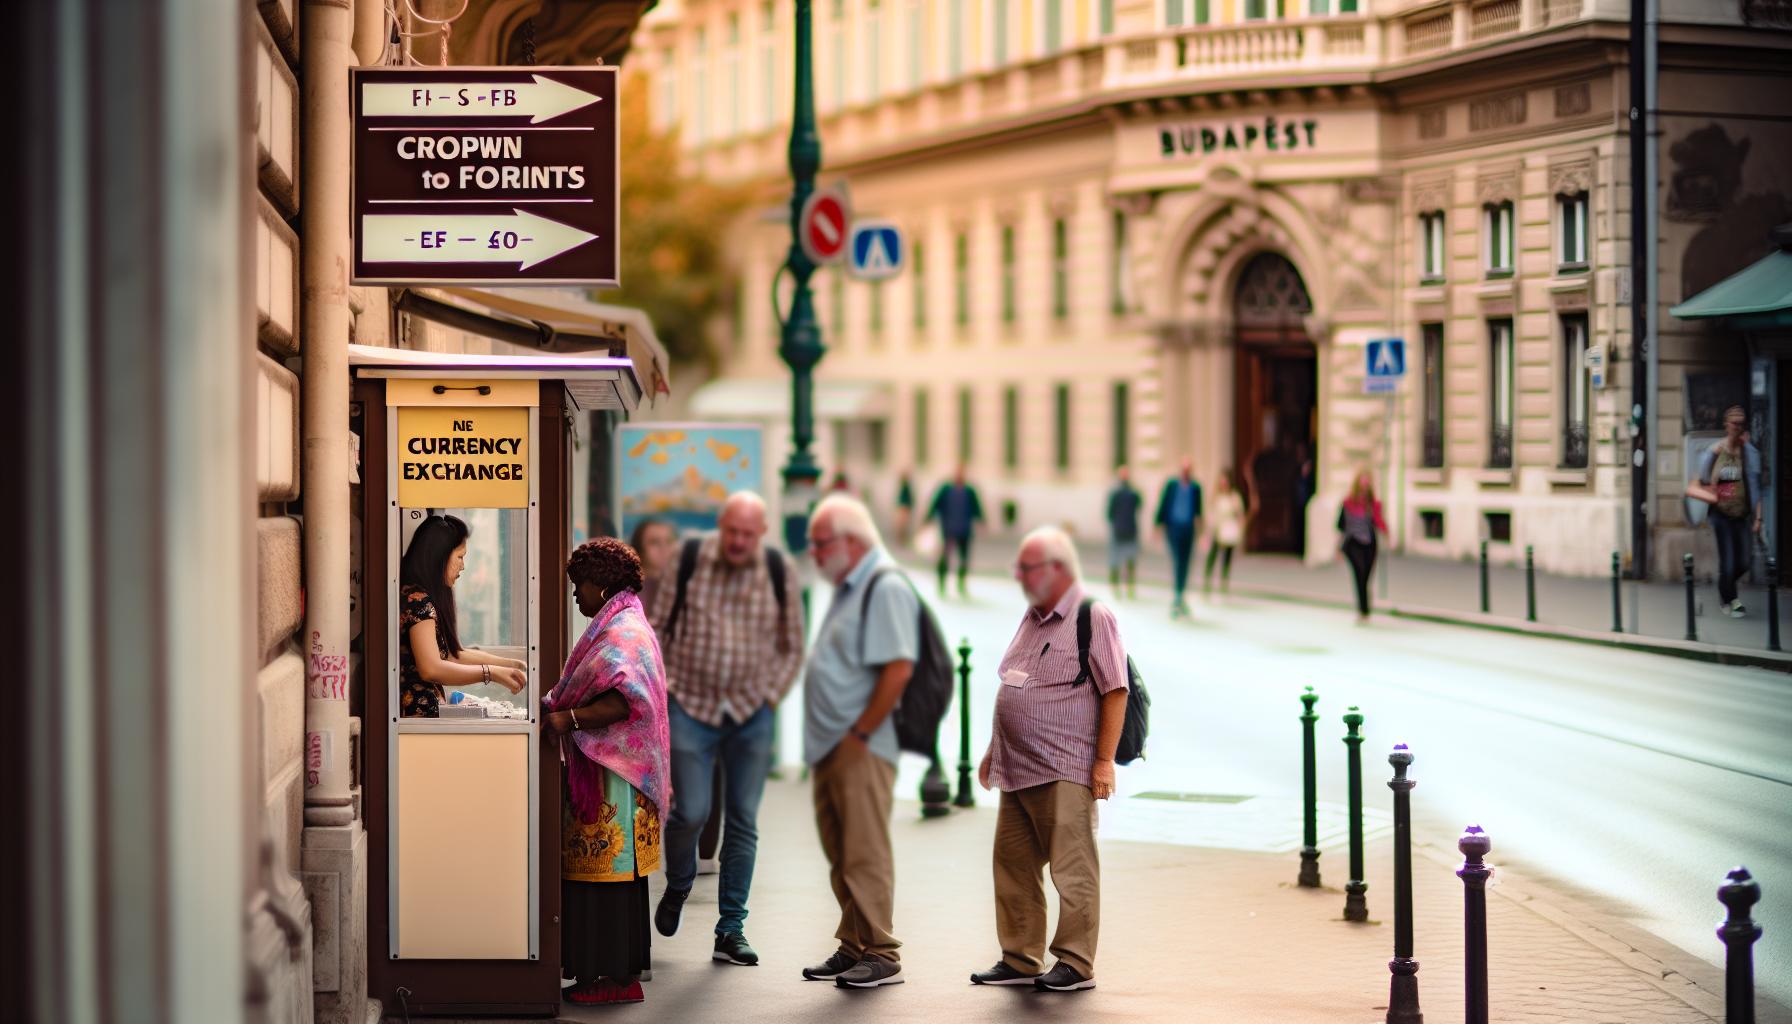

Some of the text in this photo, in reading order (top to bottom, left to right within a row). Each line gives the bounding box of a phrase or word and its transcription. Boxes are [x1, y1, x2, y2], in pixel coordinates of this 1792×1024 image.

[397, 136, 522, 160] CROPWN
[422, 165, 585, 189] to FORINTS
[408, 437, 522, 455] CURRENCY
[403, 463, 523, 480] EXCHANGE
